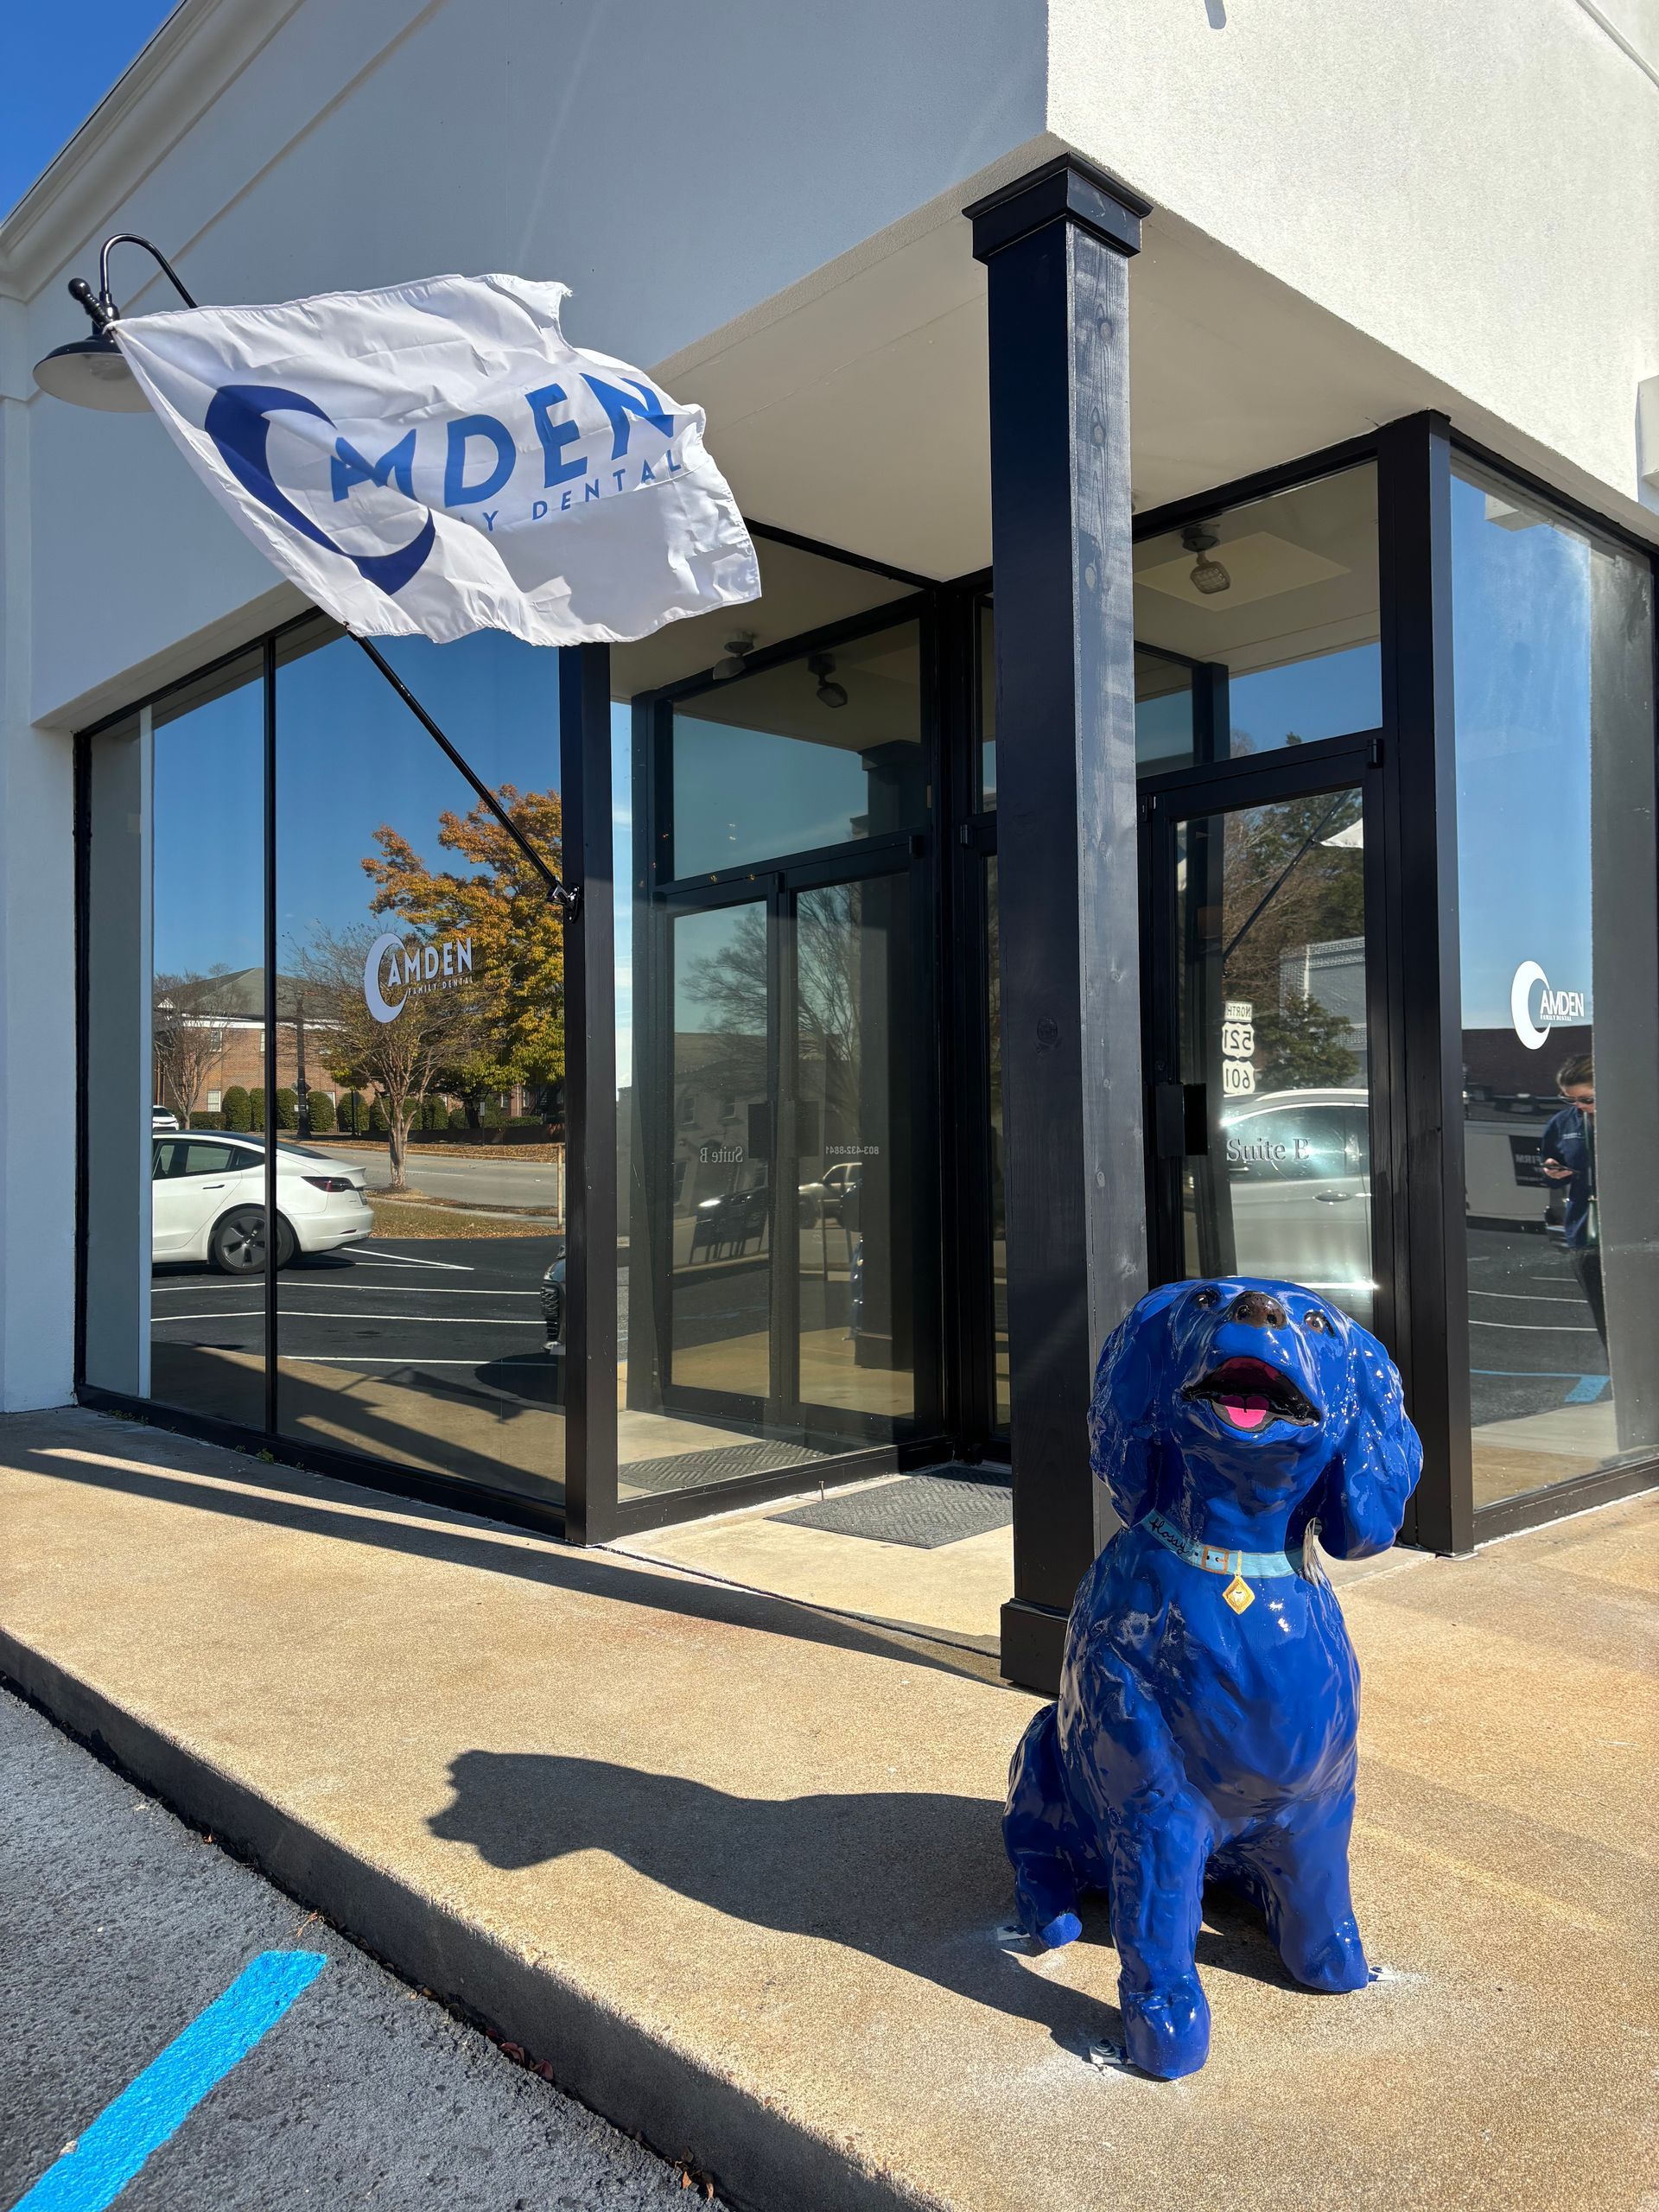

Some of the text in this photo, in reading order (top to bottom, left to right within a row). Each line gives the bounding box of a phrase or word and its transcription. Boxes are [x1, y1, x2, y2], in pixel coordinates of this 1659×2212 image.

[532, 449, 682, 520] DENTAL
[364, 933, 474, 1024] CAMDEN
[408, 976, 474, 996] FAMILY DENTAL
[1510, 960, 1585, 1050] CAMDEN
[1226, 1137, 1287, 1161] Suite
